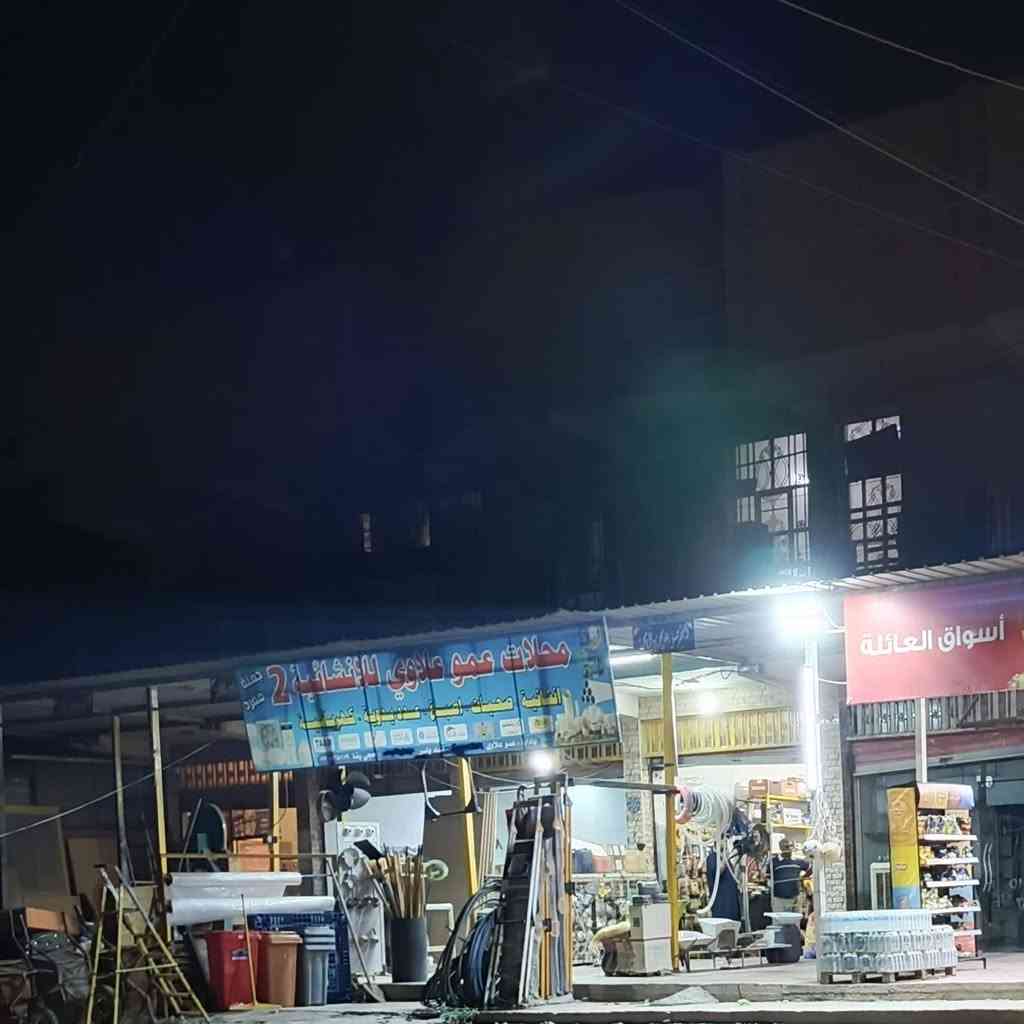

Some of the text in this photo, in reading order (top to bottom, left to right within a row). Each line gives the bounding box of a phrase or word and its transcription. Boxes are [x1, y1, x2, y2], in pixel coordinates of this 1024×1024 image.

[500, 634, 572, 673] محلات
[859, 613, 1005, 656] أسواق العائلة
[266, 664, 292, 705] 2
[451, 649, 495, 687] عمو
